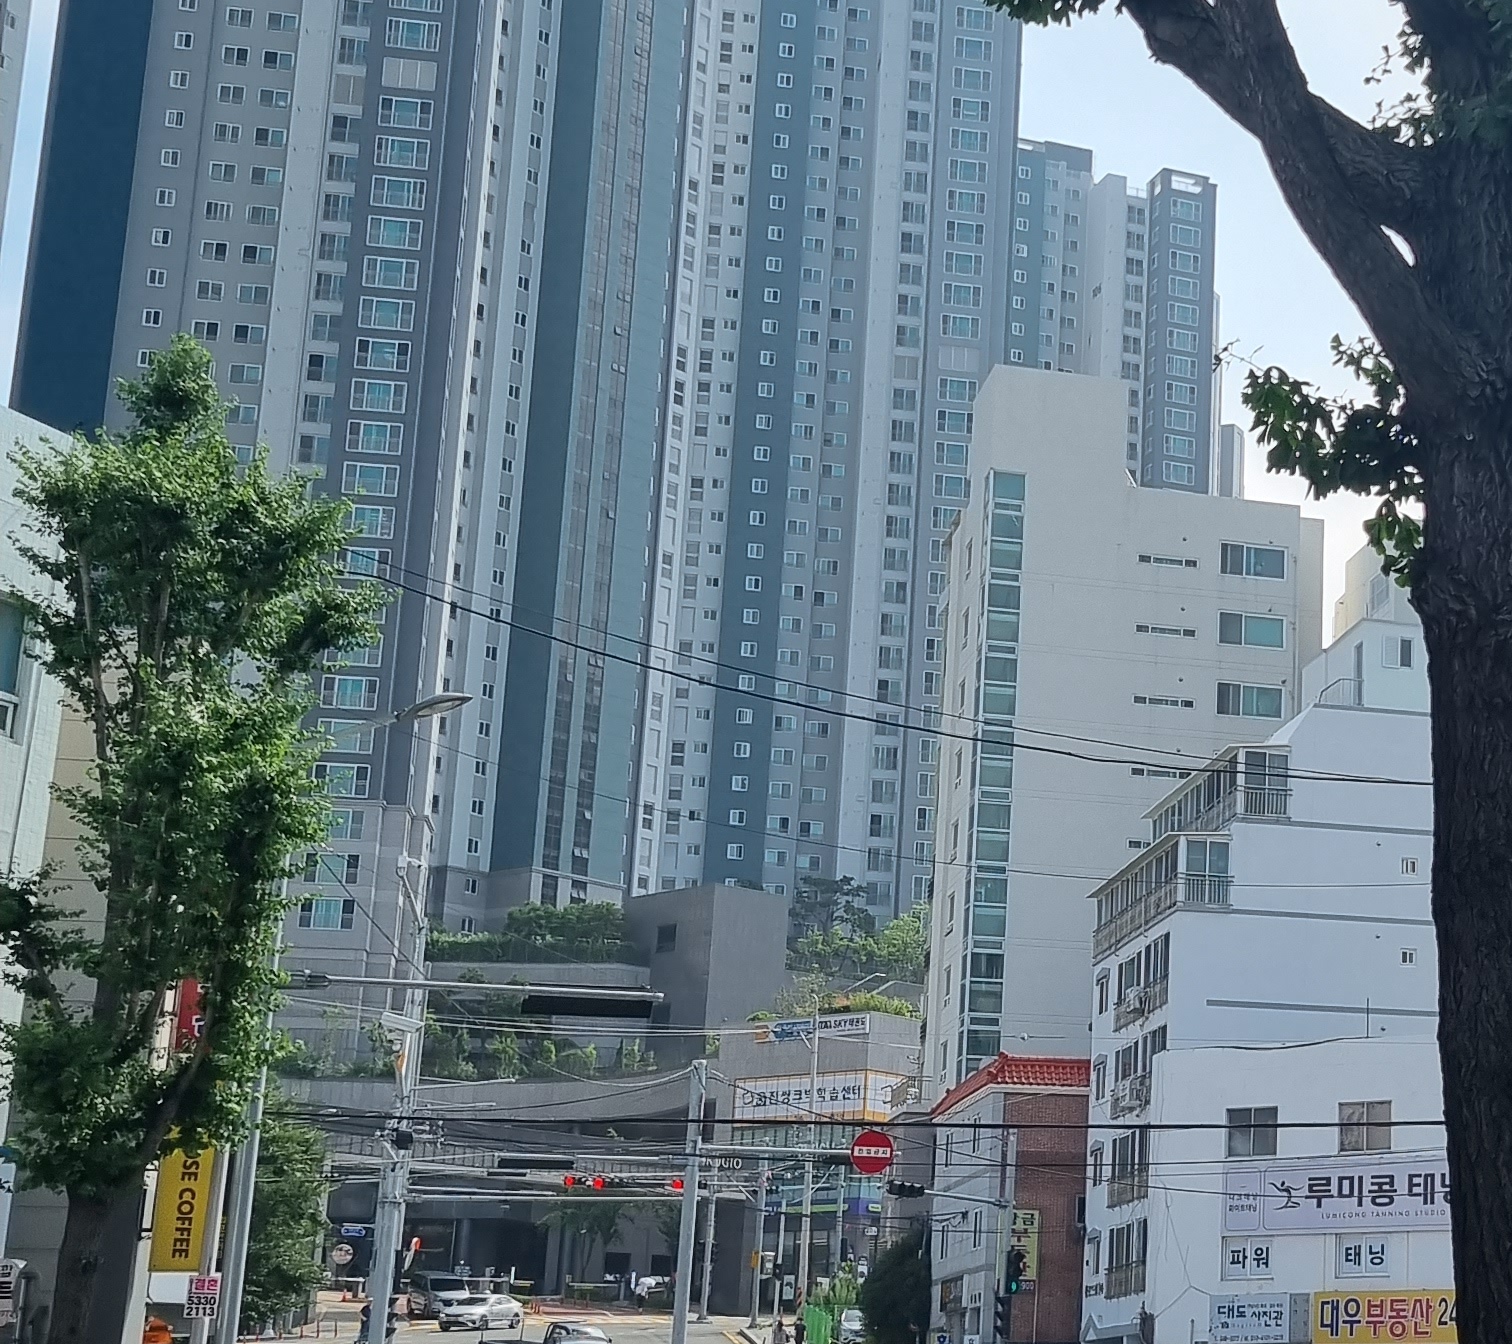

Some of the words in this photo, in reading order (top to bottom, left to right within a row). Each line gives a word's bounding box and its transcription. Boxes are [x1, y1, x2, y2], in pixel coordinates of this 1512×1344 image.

[1304, 1174, 1398, 1209] 루미콩
[171, 1187, 196, 1260] COFFEE
[1229, 1246, 1270, 1270] 파워
[1344, 1244, 1386, 1267] 태닝
[185, 1306, 215, 1317] 2113
[187, 1295, 217, 1306] 5330
[1250, 1310, 1284, 1327] 사진관
